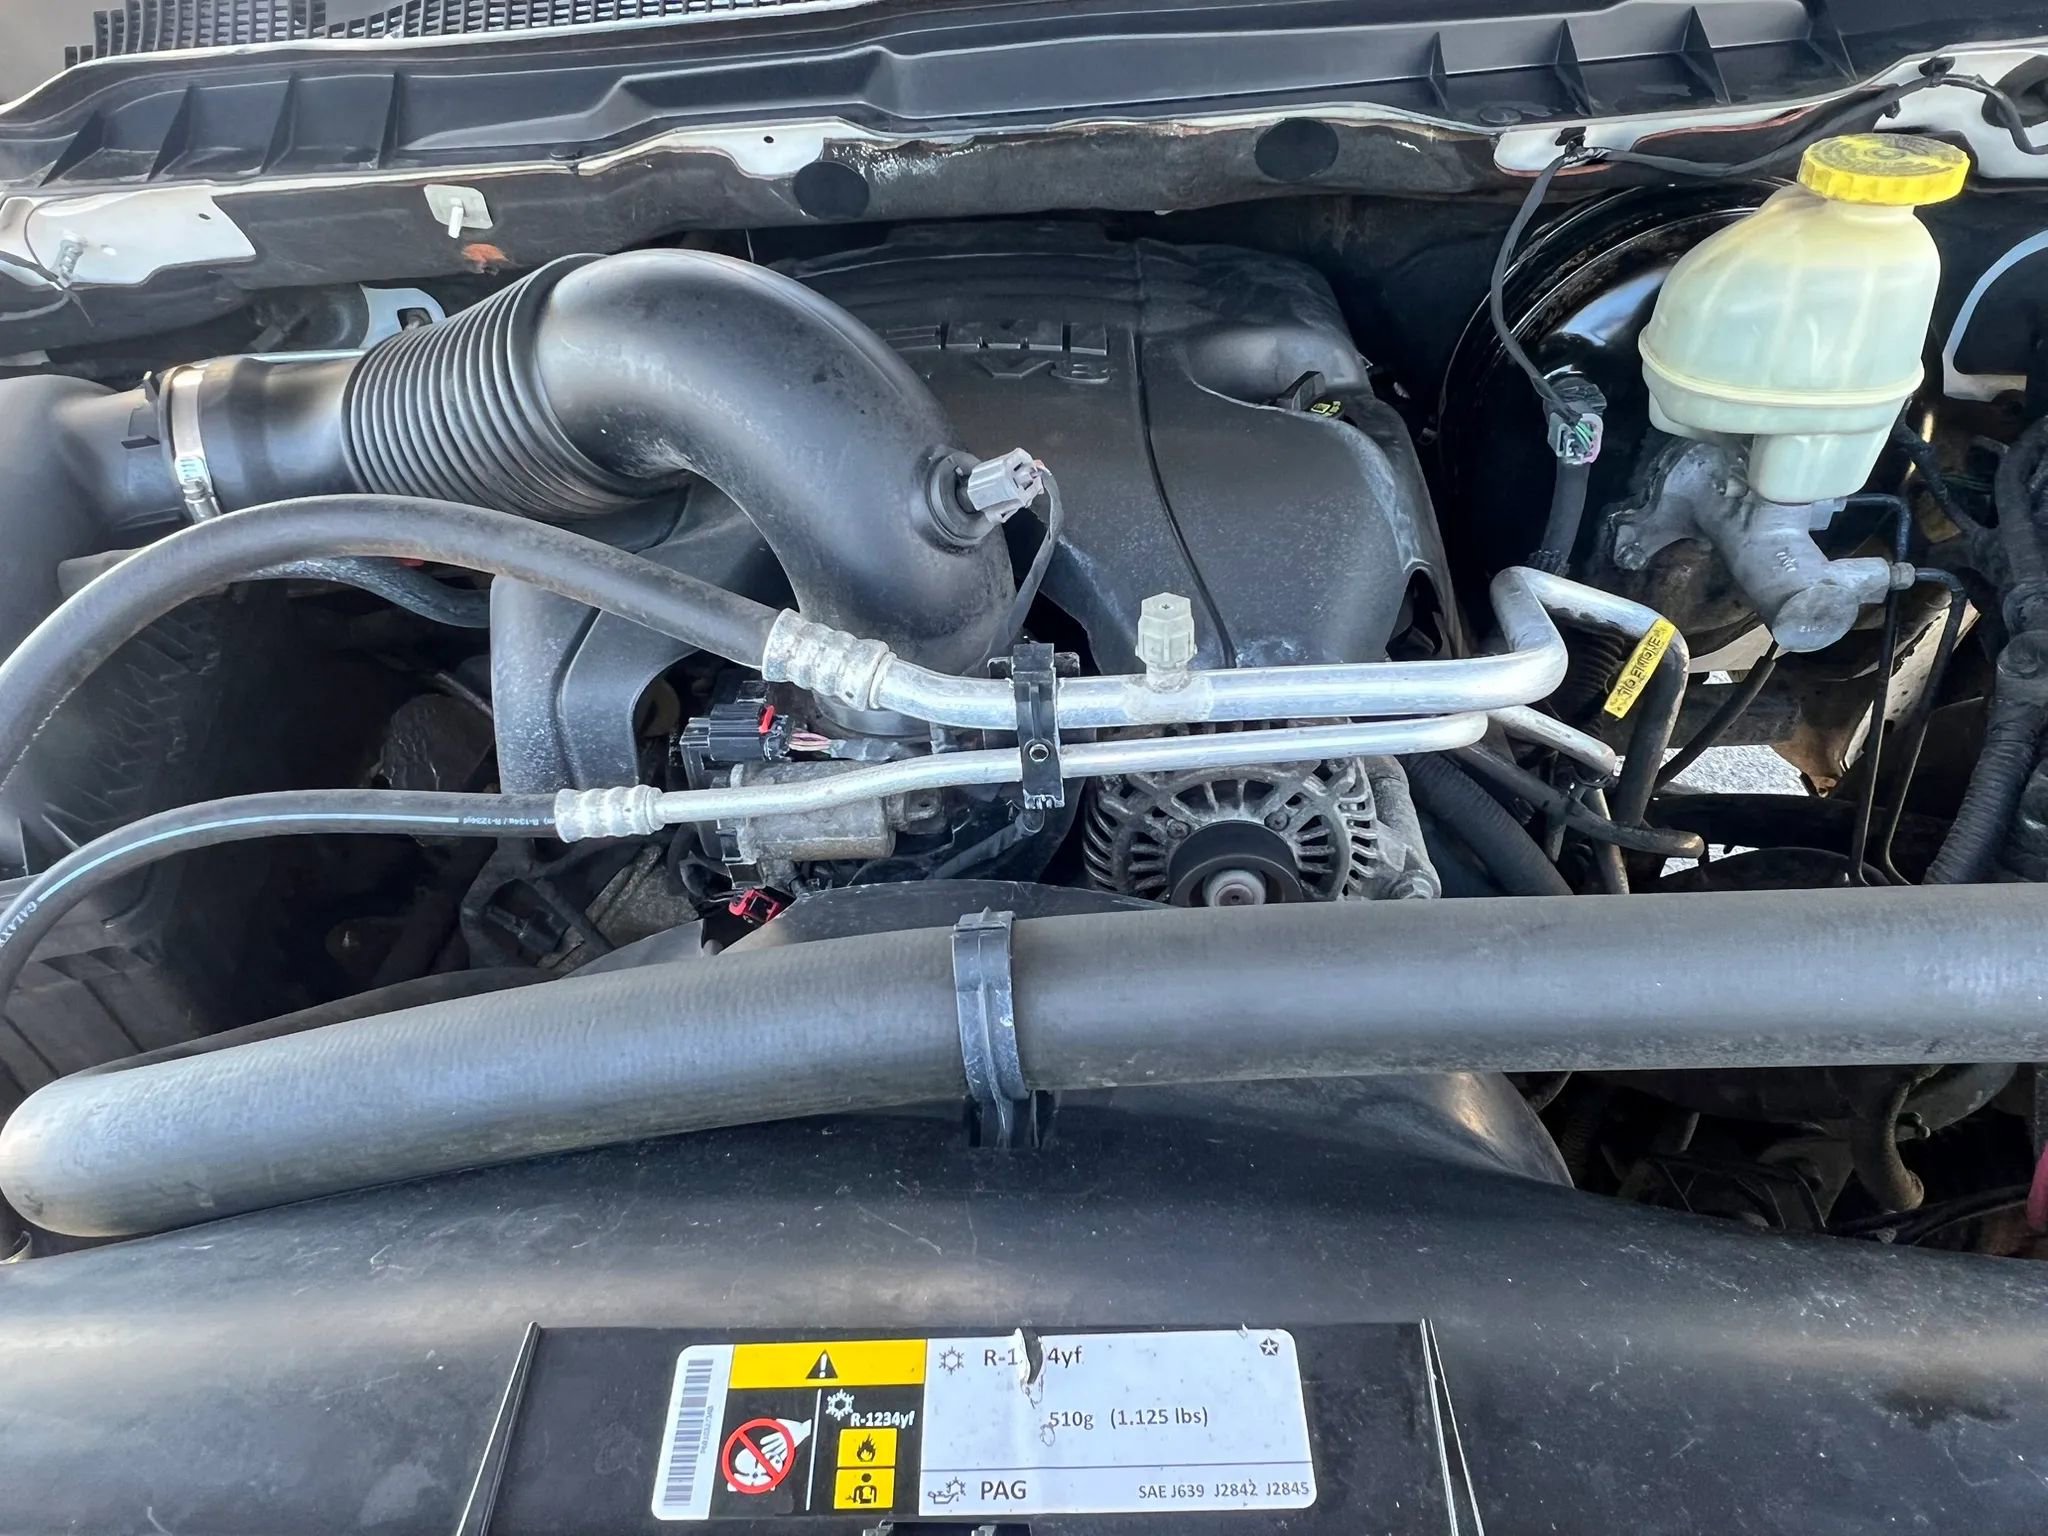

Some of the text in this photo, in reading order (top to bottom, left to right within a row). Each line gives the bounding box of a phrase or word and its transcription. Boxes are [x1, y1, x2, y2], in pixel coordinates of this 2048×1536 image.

[984, 1345, 1083, 1369] R-14yf
[850, 1410, 916, 1430] R-1234yf
[1050, 1406, 1208, 1431] 510g (1.125 lbs)
[981, 1480, 1027, 1500] PAG
[1138, 1481, 1310, 1499] SAE J639 J2842 J2845
